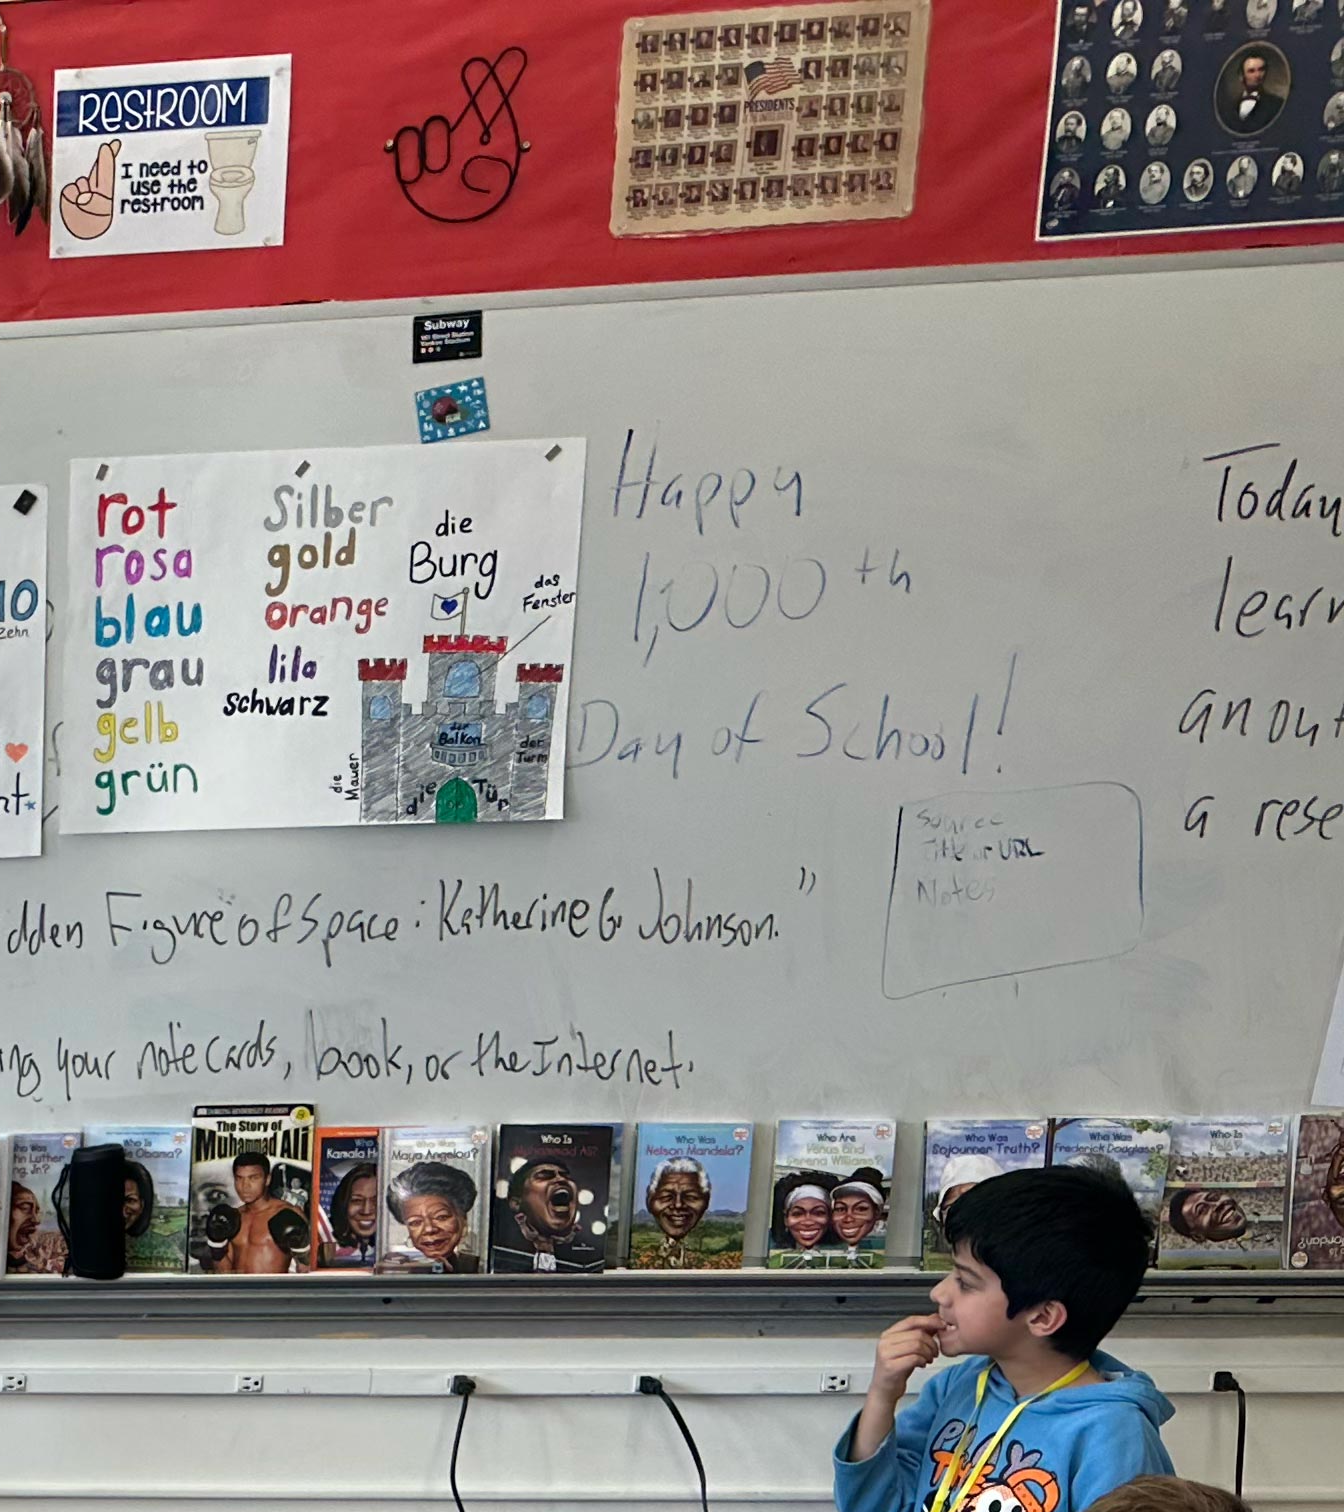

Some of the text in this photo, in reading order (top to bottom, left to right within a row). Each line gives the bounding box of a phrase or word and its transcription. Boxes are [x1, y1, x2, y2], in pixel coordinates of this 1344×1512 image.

[744, 98, 794, 113] PRESIDENTS
[121, 159, 208, 179] I need to
[130, 176, 197, 196] use the
[120, 195, 204, 214] restroom
[424, 319, 470, 332] Subway
[611, 421, 804, 535] Happy
[1202, 442, 1344, 537] Today
[96, 487, 177, 538] rot
[434, 509, 473, 538] die
[94, 544, 192, 588] rosa
[264, 528, 357, 598] gold
[409, 540, 498, 600] Burg
[534, 572, 561, 590] das
[522, 587, 576, 611] Fenster
[94, 592, 203, 648] blau
[263, 594, 389, 635] orange
[267, 643, 318, 686] lila
[94, 655, 204, 709] grau
[567, 652, 1017, 779] Day of School!
[93, 699, 179, 763] gelb
[519, 736, 544, 750] der
[515, 751, 548, 764] Turm
[331, 774, 343, 793] die
[345, 753, 360, 801] Mauer
[94, 762, 199, 816] grün
[406, 778, 510, 816] die Tür
[106, 892, 229, 965] Figure
[239, 893, 294, 947] of
[438, 878, 590, 942] Katherine
[57, 1036, 117, 1102] your
[306, 1010, 413, 1086] book,
[424, 1045, 464, 1081] or
[471, 1032, 530, 1073] the
[217, 1120, 282, 1132] The Story of
[1210, 1129, 1231, 1140] Who
[195, 1126, 309, 1162] Muhammad Ali
[541, 1134, 560, 1145] Who
[674, 1135, 716, 1145] Who Was
[817, 1133, 856, 1143] Who Are
[964, 1133, 1009, 1143] Who Was
[1089, 1131, 1133, 1142] Who Was
[136, 1148, 182, 1159] Obama?
[327, 1149, 365, 1159] Kamala
[392, 1147, 478, 1162] Maya Angelou?
[647, 1145, 744, 1157] Nelson Mandela?
[932, 1142, 1040, 1157] Sojourner Truth?
[1054, 1142, 1105, 1154] Frederick
[29, 1154, 64, 1164] Luther
